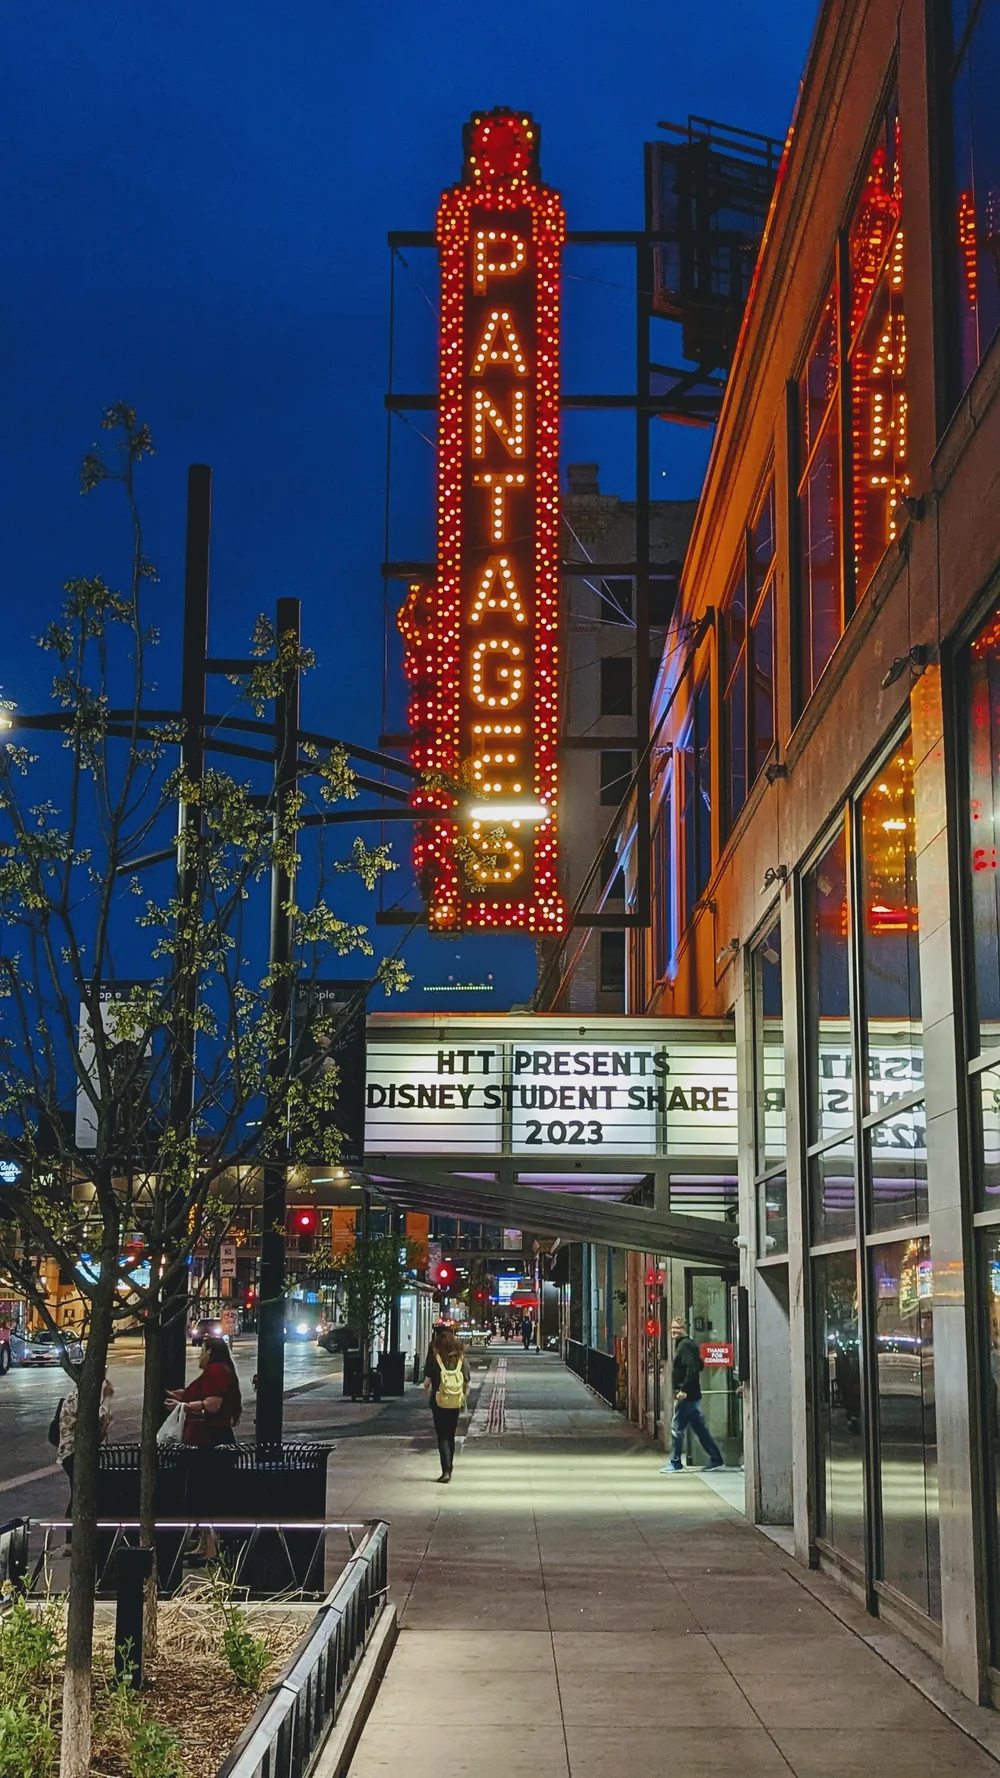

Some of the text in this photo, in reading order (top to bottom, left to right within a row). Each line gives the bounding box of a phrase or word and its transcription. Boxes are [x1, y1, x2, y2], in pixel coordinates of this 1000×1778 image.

[467, 230, 528, 883] PANTAGES
[299, 990, 335, 1001] Pople
[437, 1050, 670, 1078] HTT PRESENTS
[367, 1083, 475, 1109] DISNEY
[483, 1084, 617, 1111] STUDENT
[627, 1085, 729, 1112] SHARE
[525, 1119, 603, 1145] 2023
